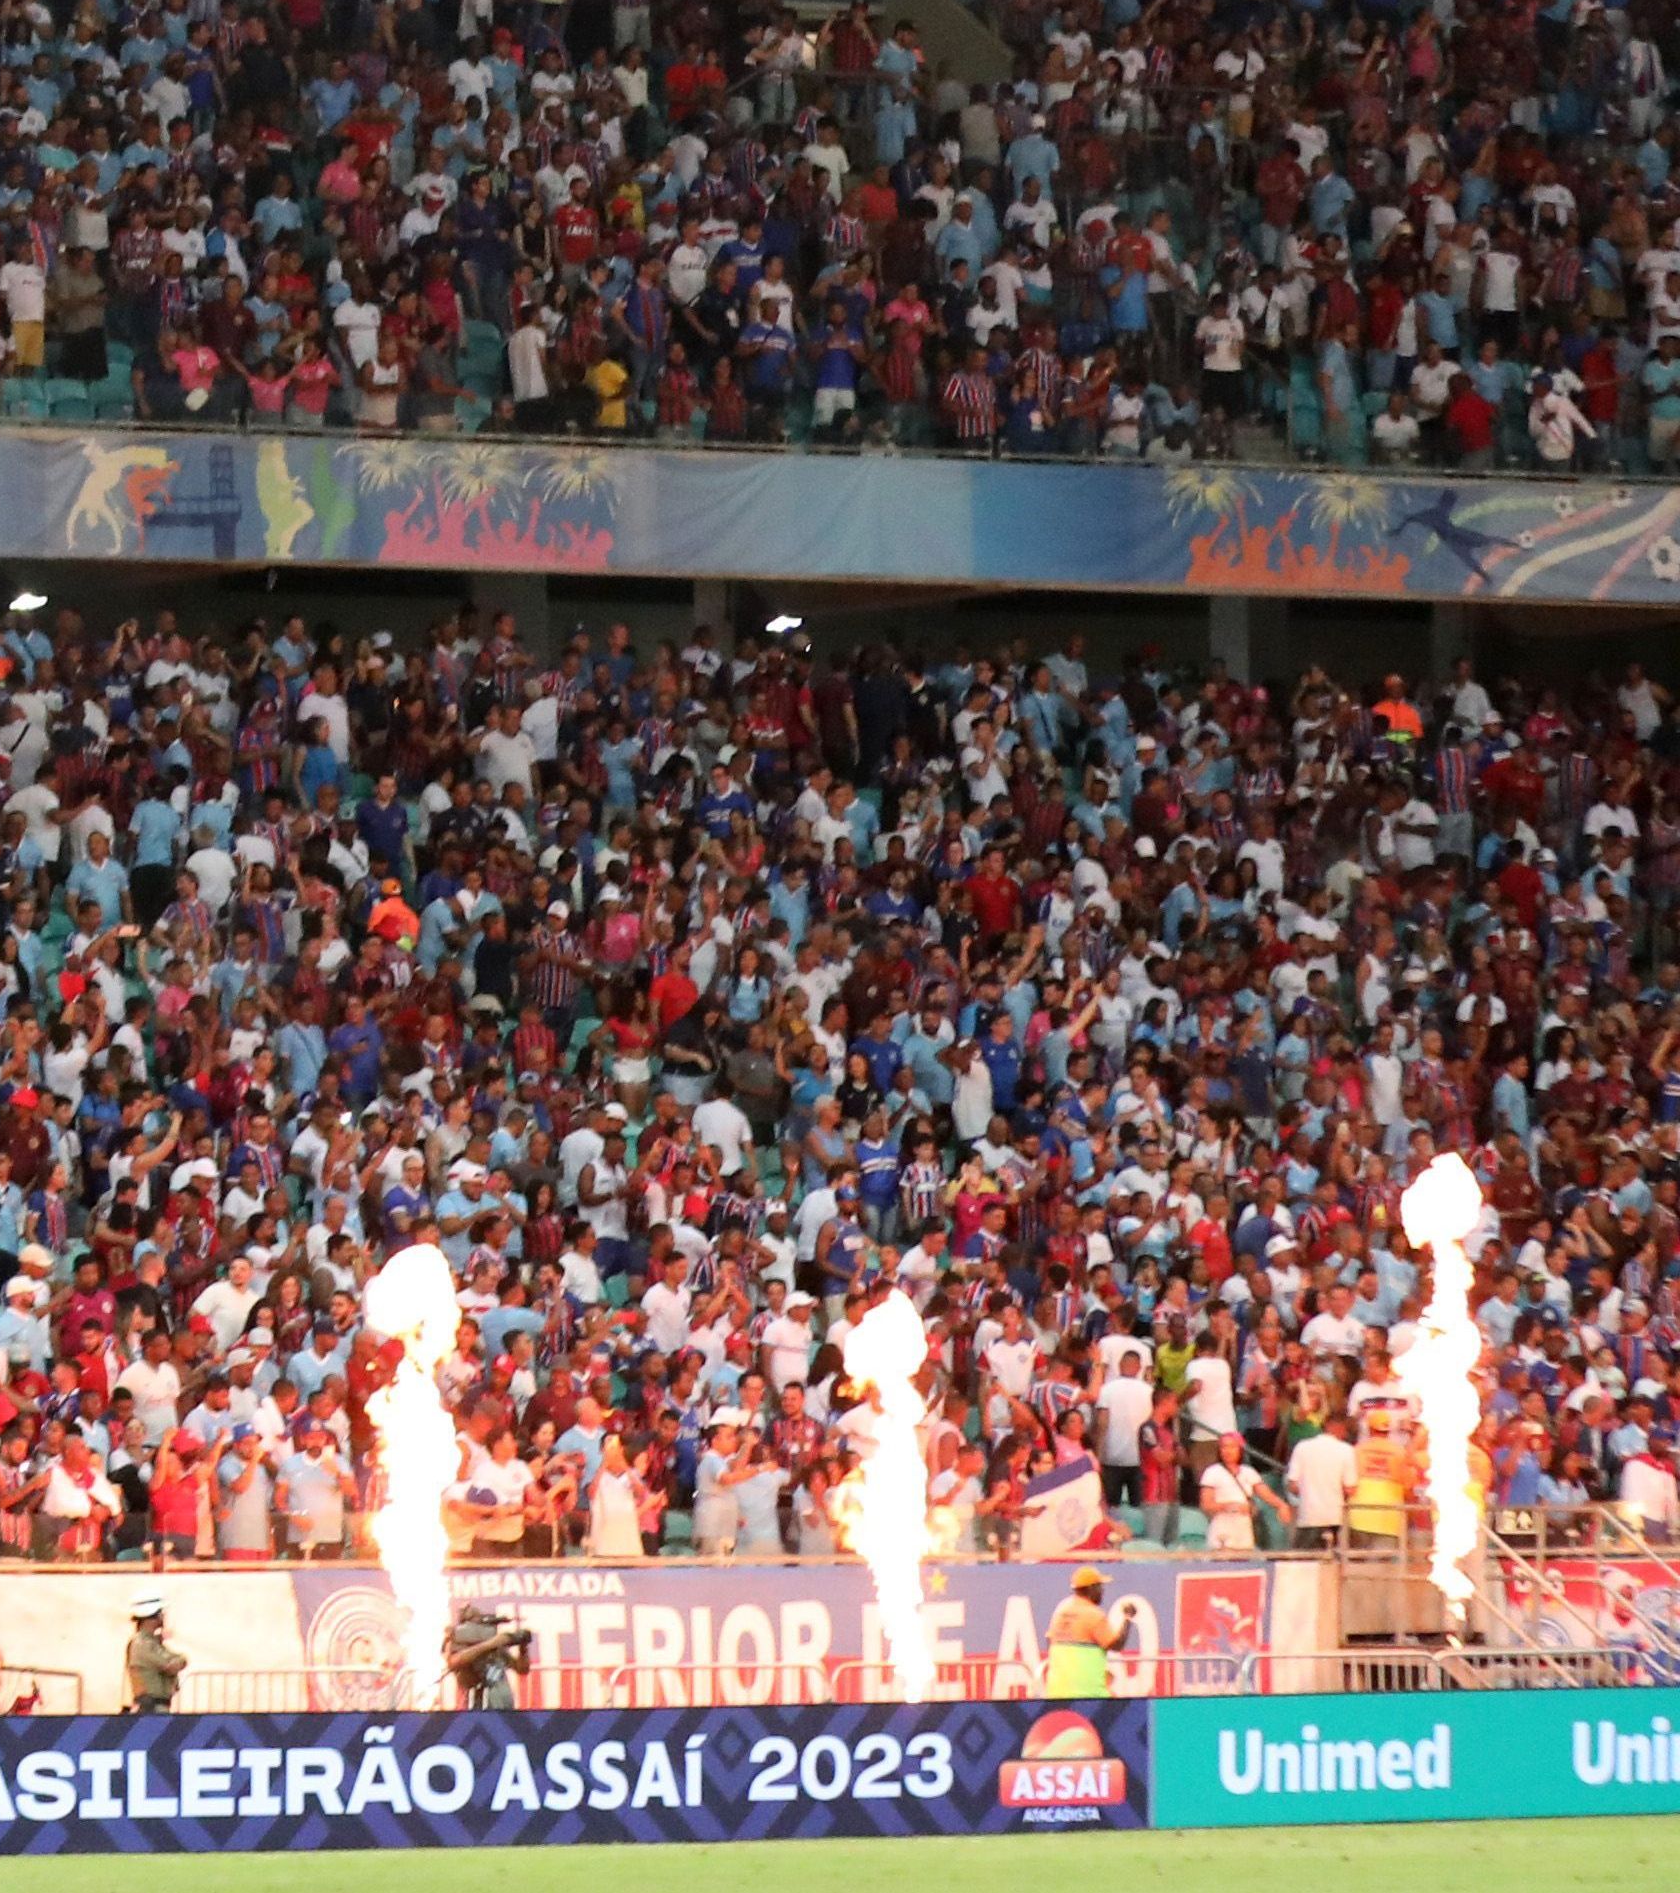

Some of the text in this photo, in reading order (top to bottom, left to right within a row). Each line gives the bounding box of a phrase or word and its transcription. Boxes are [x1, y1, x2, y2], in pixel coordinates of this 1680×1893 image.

[749, 1732, 955, 1803] 2023
[1218, 1723, 1452, 1795] Unimed
[1571, 1716, 1680, 1786] Uni
